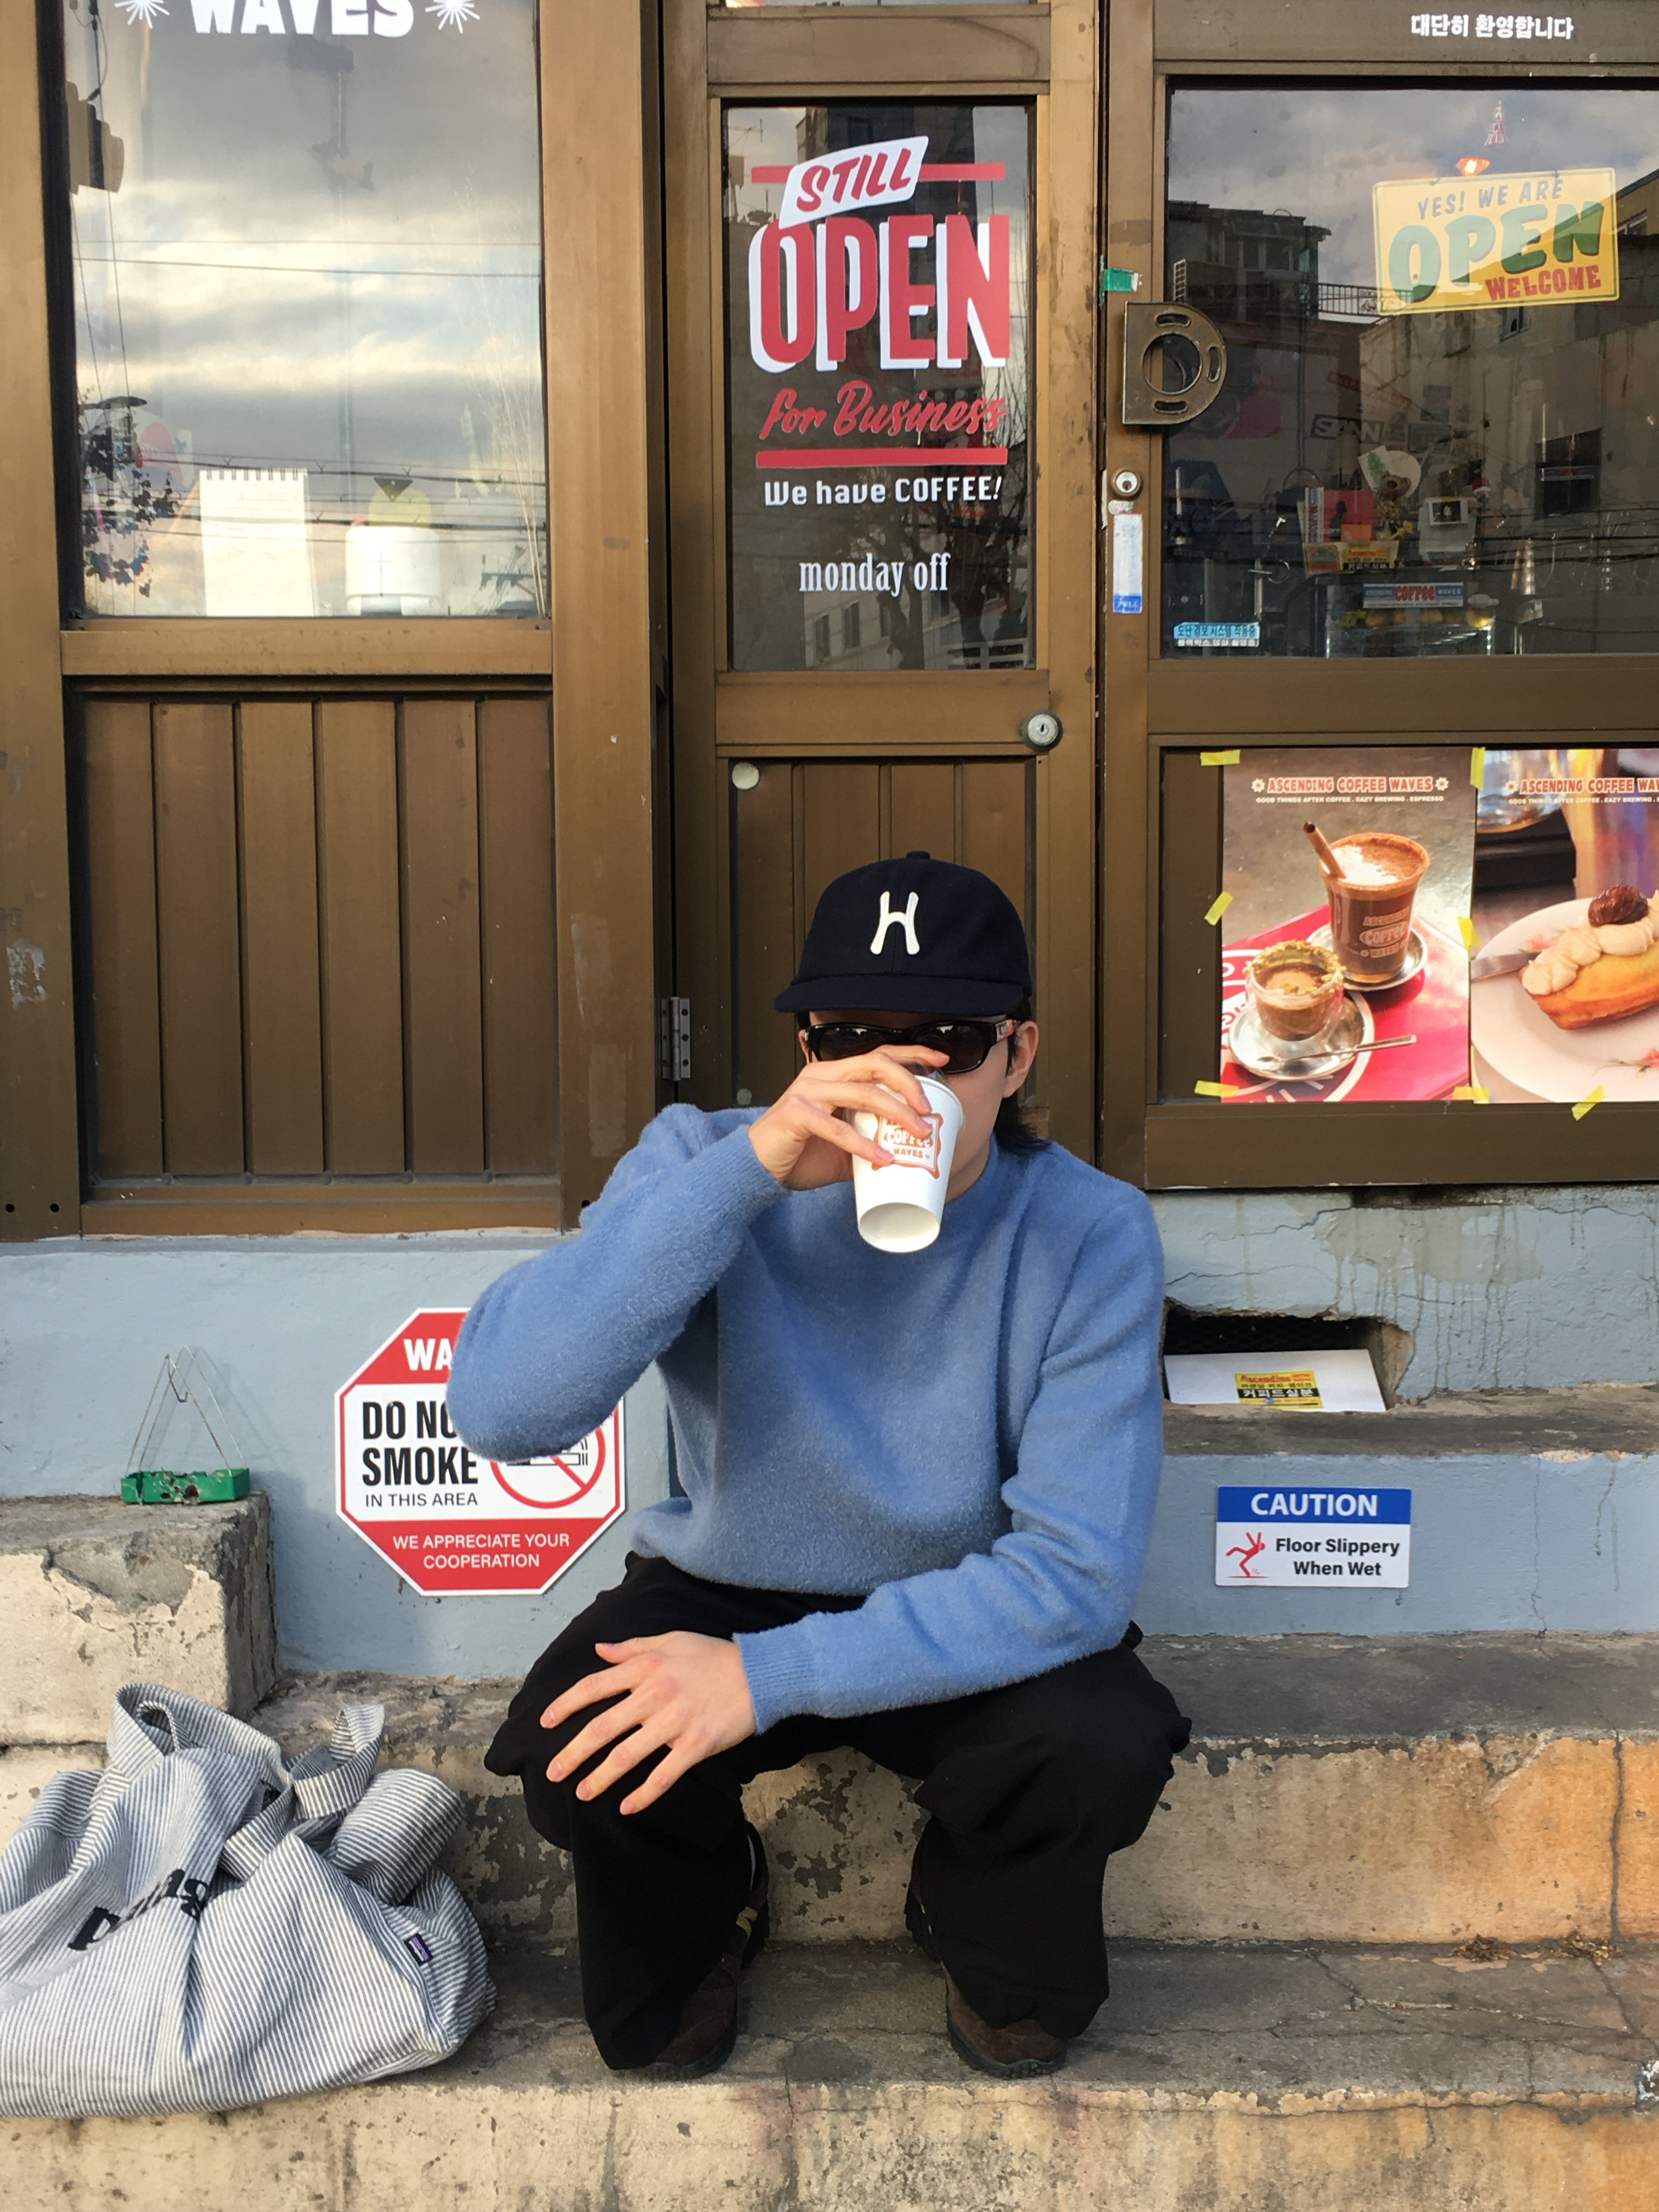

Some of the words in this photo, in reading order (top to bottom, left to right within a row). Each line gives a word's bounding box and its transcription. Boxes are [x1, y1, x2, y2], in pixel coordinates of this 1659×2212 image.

[1411, 14, 1469, 37] 대단히
[1475, 14, 1574, 40] 환영합니다
[797, 148, 911, 212] STILL
[1418, 191, 1465, 219] YES!
[1479, 185, 1508, 208] WE
[1520, 178, 1564, 205] ARE
[1389, 201, 1604, 303] OPEN
[749, 214, 1010, 374] OPEN
[1485, 264, 1601, 301] WELCOME
[759, 387, 826, 439] for
[834, 380, 1008, 436] Business
[765, 482, 807, 506] We
[816, 481, 885, 504] have
[895, 476, 1002, 503] COFFEE!
[799, 553, 904, 597] monday
[913, 552, 951, 591] off
[1267, 777, 1334, 793] ASCENDING
[1337, 777, 1386, 793] COFFEE
[1389, 776, 1433, 792] WAVES
[1520, 778, 1584, 794] ASCENDING
[1588, 777, 1634, 794] COFFEE
[870, 891, 920, 955] H
[894, 1148, 923, 1159] WAVES
[1243, 1389, 1313, 1397] 커피드실분
[363, 1401, 406, 1440] DO
[362, 1446, 478, 1486] SMOKE
[366, 1494, 382, 1507] IN
[388, 1494, 427, 1506] THIS
[432, 1493, 478, 1506] AREA
[1251, 1493, 1378, 1516] CAUTION
[393, 1536, 419, 1550] WE
[423, 1534, 521, 1549] APPRECIATE
[524, 1533, 569, 1548] YOUR
[1276, 1538, 1322, 1552] Floor
[1325, 1539, 1400, 1556] Slippery
[424, 1554, 540, 1569] COOPERATION
[1294, 1561, 1343, 1576] When
[1348, 1562, 1381, 1576] Wet
